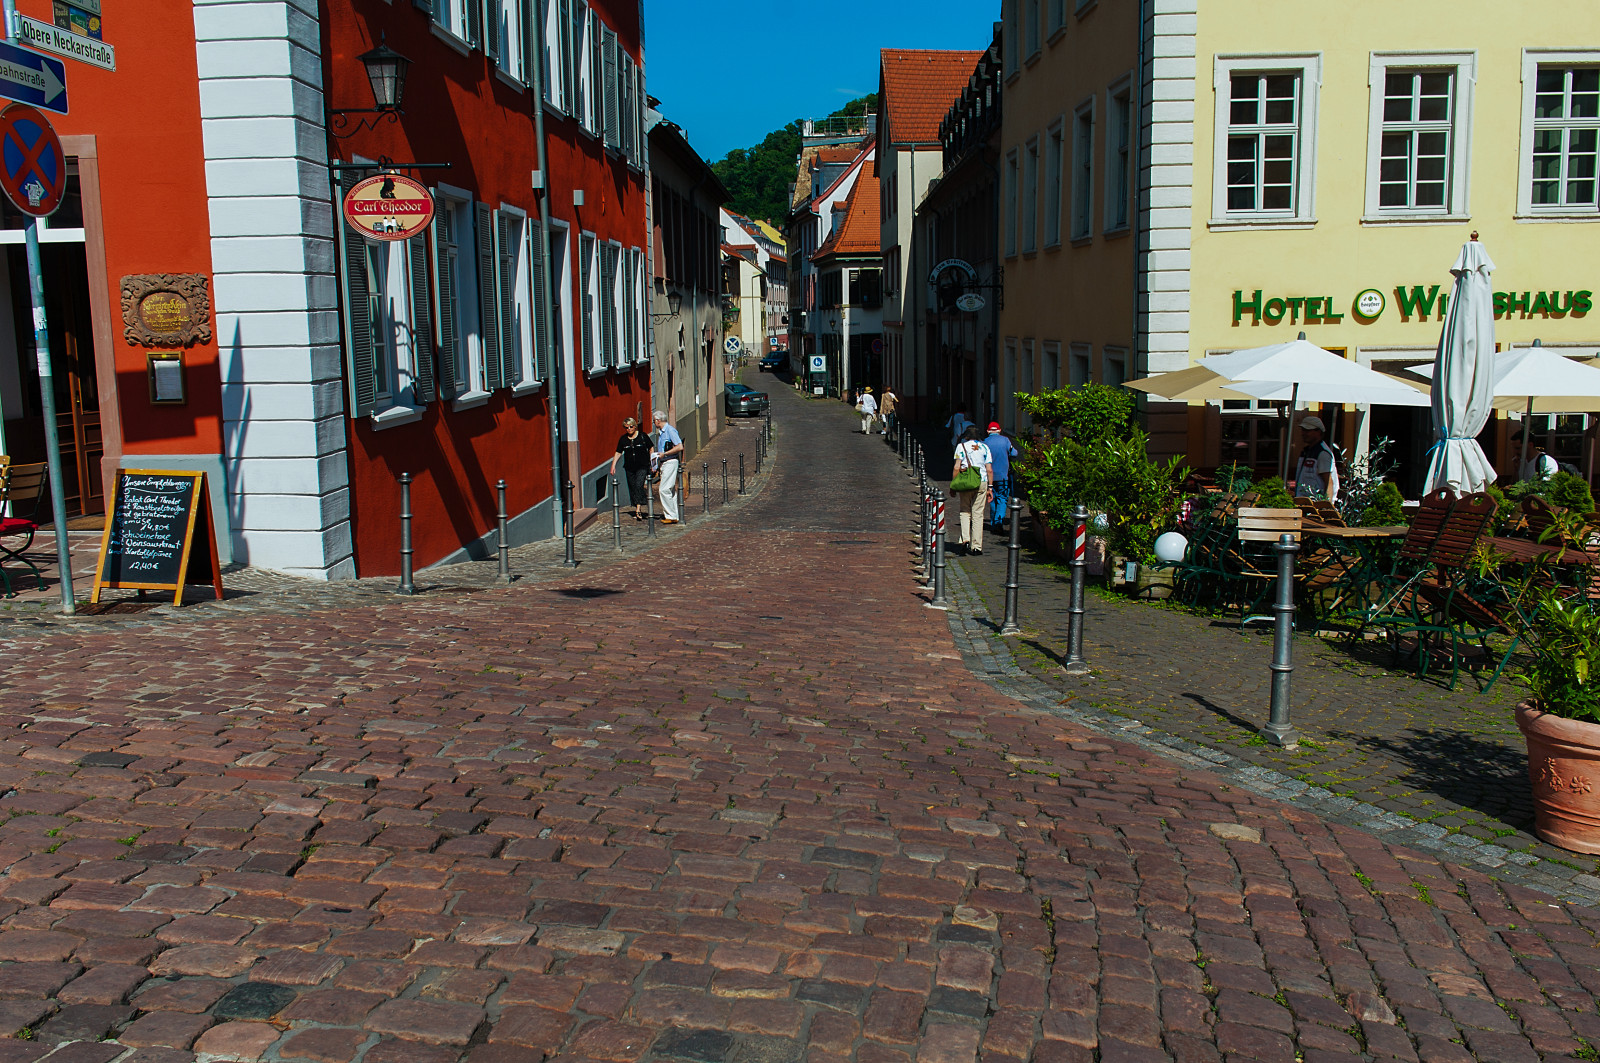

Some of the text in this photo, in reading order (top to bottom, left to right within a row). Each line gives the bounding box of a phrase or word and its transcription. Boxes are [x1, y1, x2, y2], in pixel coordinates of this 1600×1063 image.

[23, 20, 111, 65] Obere Neckarstraße
[354, 199, 422, 215] Carl Theodor
[1234, 284, 1593, 321] HOTEL WISHAUS
[122, 475, 192, 490] Unsere Empfehlungen
[143, 495, 159, 504] Carl
[159, 495, 182, 505] Theodor
[140, 522, 171, 531] 14,80€
[128, 561, 160, 571] 12,40€
